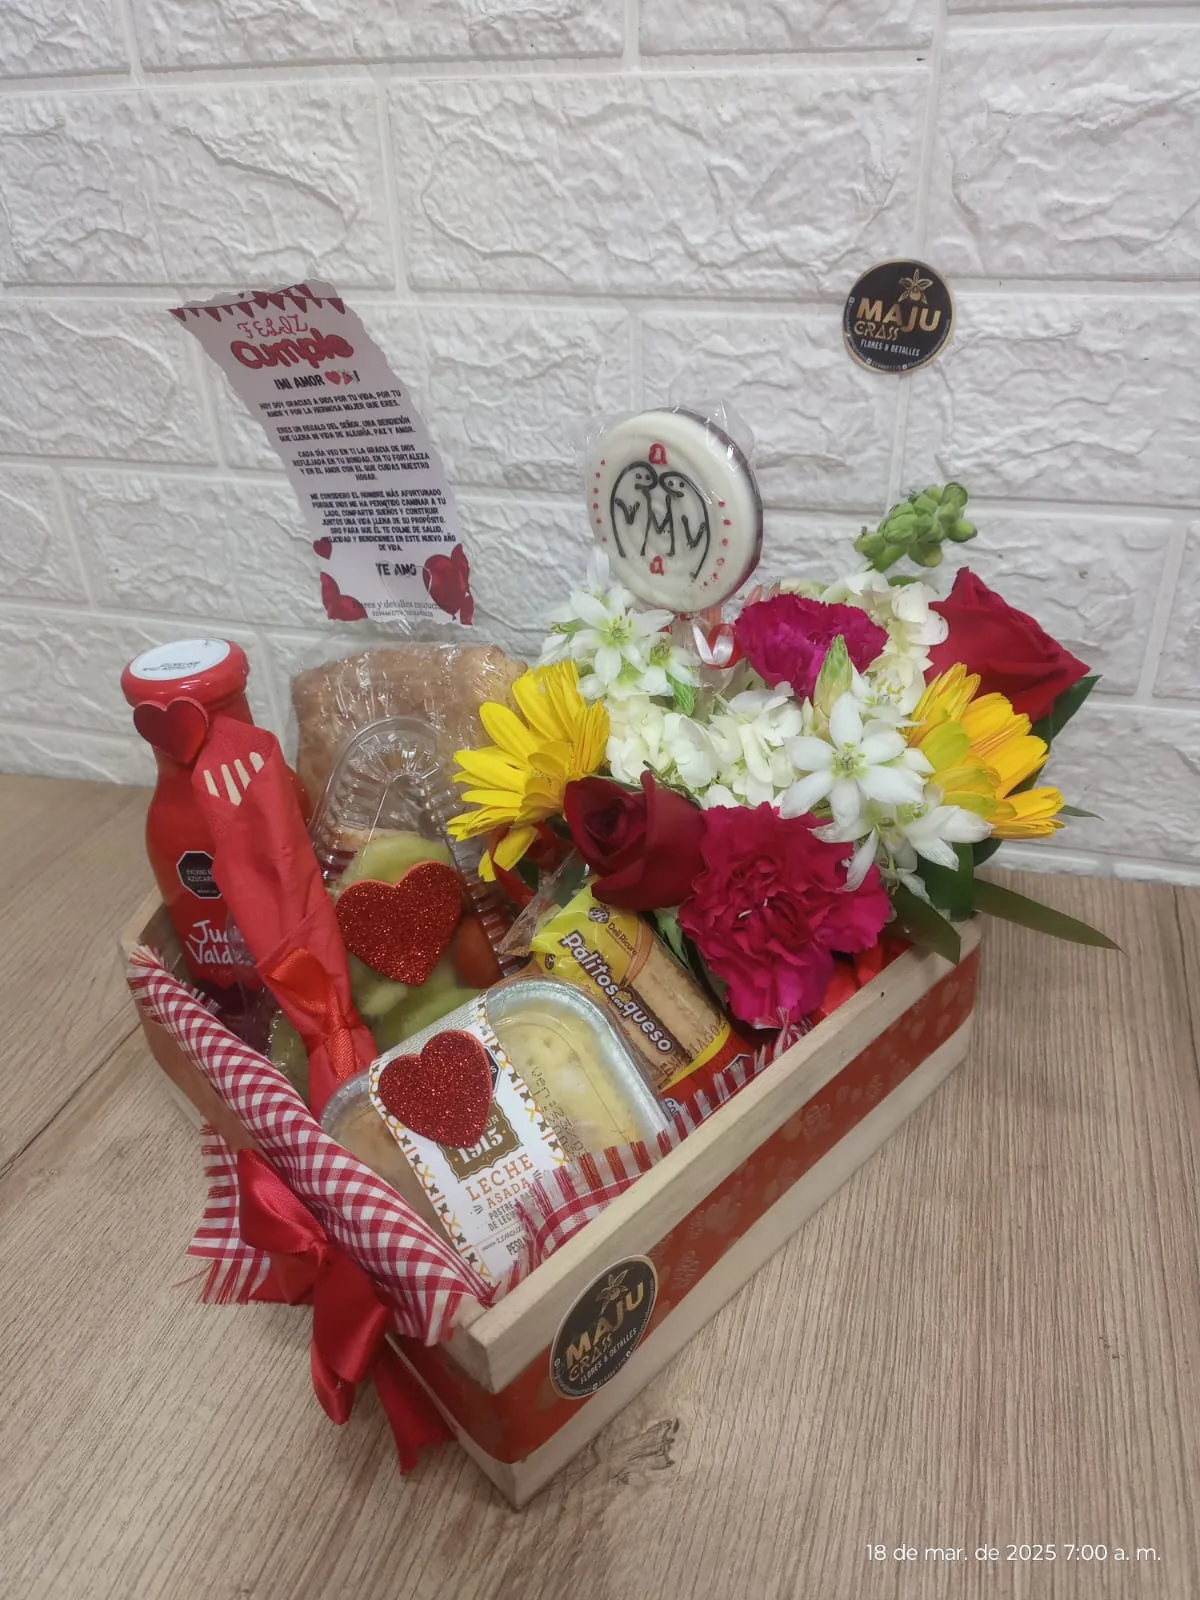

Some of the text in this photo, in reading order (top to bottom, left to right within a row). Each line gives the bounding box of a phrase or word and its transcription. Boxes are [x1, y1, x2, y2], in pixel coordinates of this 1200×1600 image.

[856, 297, 942, 333] MAJU
[237, 313, 308, 339] FELIZ
[861, 338, 883, 351] FLORES
[890, 344, 921, 357] DETALLES
[295, 374, 326, 389] AMOR
[285, 399, 313, 407] GRACIAS
[318, 396, 334, 404] DIOS
[347, 394, 358, 402] TU
[376, 390, 391, 398] POR
[391, 390, 402, 398] TU
[267, 410, 284, 418] AMOR
[290, 408, 303, 416] POR
[312, 404, 343, 414] HERMOSA
[343, 402, 366, 410] MUJER
[276, 426, 293, 434] ERES
[302, 423, 326, 432] REGALO
[326, 422, 339, 430] DEL
[376, 415, 411, 426] BENDICIÓN
[319, 431, 334, 440] VIDA
[298, 450, 314, 458] CADA
[314, 448, 326, 457] DÍA
[339, 448, 350, 456] EN
[366, 446, 390, 454] GRACIA
[400, 444, 416, 452] DIOS
[292, 458, 327, 466] REFLEJADA
[382, 454, 392, 462] TU
[392, 452, 430, 462] FORTALEZA
[299, 468, 306, 476] Y
[324, 466, 341, 474] AMOR
[340, 465, 355, 473] CON
[363, 464, 377, 472] QUE
[377, 463, 400, 471] CUIDAS
[400, 462, 430, 470] NUESTRO
[310, 492, 319, 500] ME
[320, 492, 351, 500] CONSIDERO
[360, 490, 385, 498] HOMBRE
[385, 488, 400, 498] MÁS
[400, 488, 442, 496] AFORTUNADO
[334, 500, 348, 508] DIOS
[348, 500, 358, 508] ME
[401, 498, 430, 506] CAMINAR
[431, 498, 436, 506] A
[436, 497, 446, 505] TU
[342, 508, 374, 516] COMPARTIR
[405, 506, 439, 515] CONSTRUIR
[322, 518, 343, 526] JUNTOS
[343, 518, 357, 526] UNA
[358, 518, 372, 526] VIDA
[372, 517, 392, 525] LLENA
[402, 516, 410, 524] SU
[360, 526, 373, 534] QUE
[382, 526, 390, 534] TE
[391, 526, 412, 534] COLME
[421, 534, 442, 542] NUEVO
[444, 532, 456, 542] AÑO
[378, 544, 387, 552] DE
[375, 562, 417, 577] TE AMO
[607, 922, 622, 939] Deli
[557, 929, 620, 997] Palitos
[621, 1000, 672, 1052] queso
[464, 1153, 535, 1201] LECHE
[486, 1181, 531, 1209] ASADA
[488, 1200, 515, 1220] POSTRE
[488, 1221, 499, 1232] DE
[565, 1282, 644, 1370] MAJU
[580, 1361, 602, 1385] FLORES
[609, 1327, 637, 1357] DETALLES
